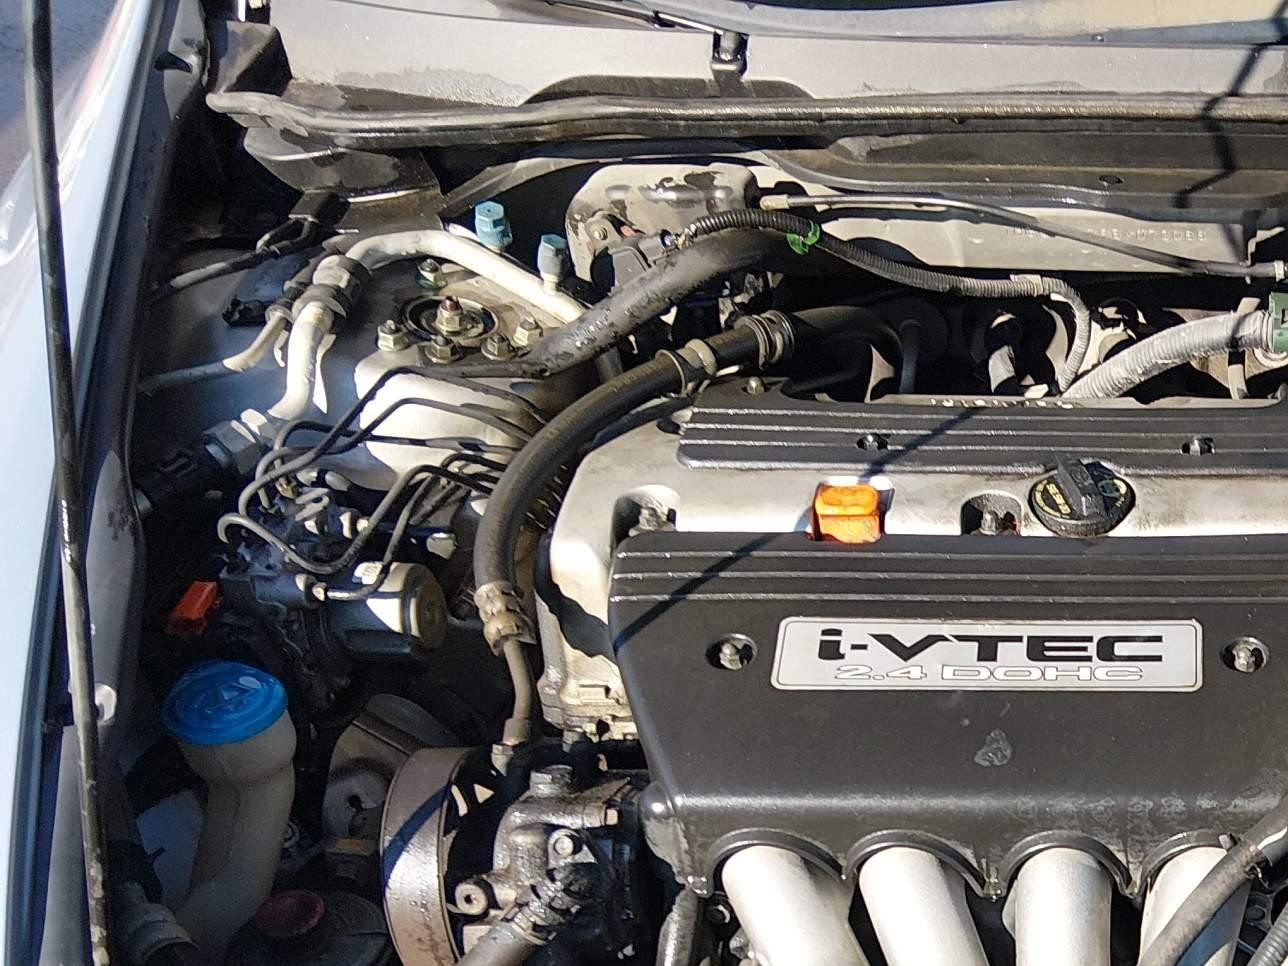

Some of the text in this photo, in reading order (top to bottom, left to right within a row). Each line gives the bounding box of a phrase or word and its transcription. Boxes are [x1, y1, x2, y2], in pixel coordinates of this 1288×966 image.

[818, 628, 1163, 662] i-VTEC
[834, 663, 1142, 682] 2.4 DOHC
